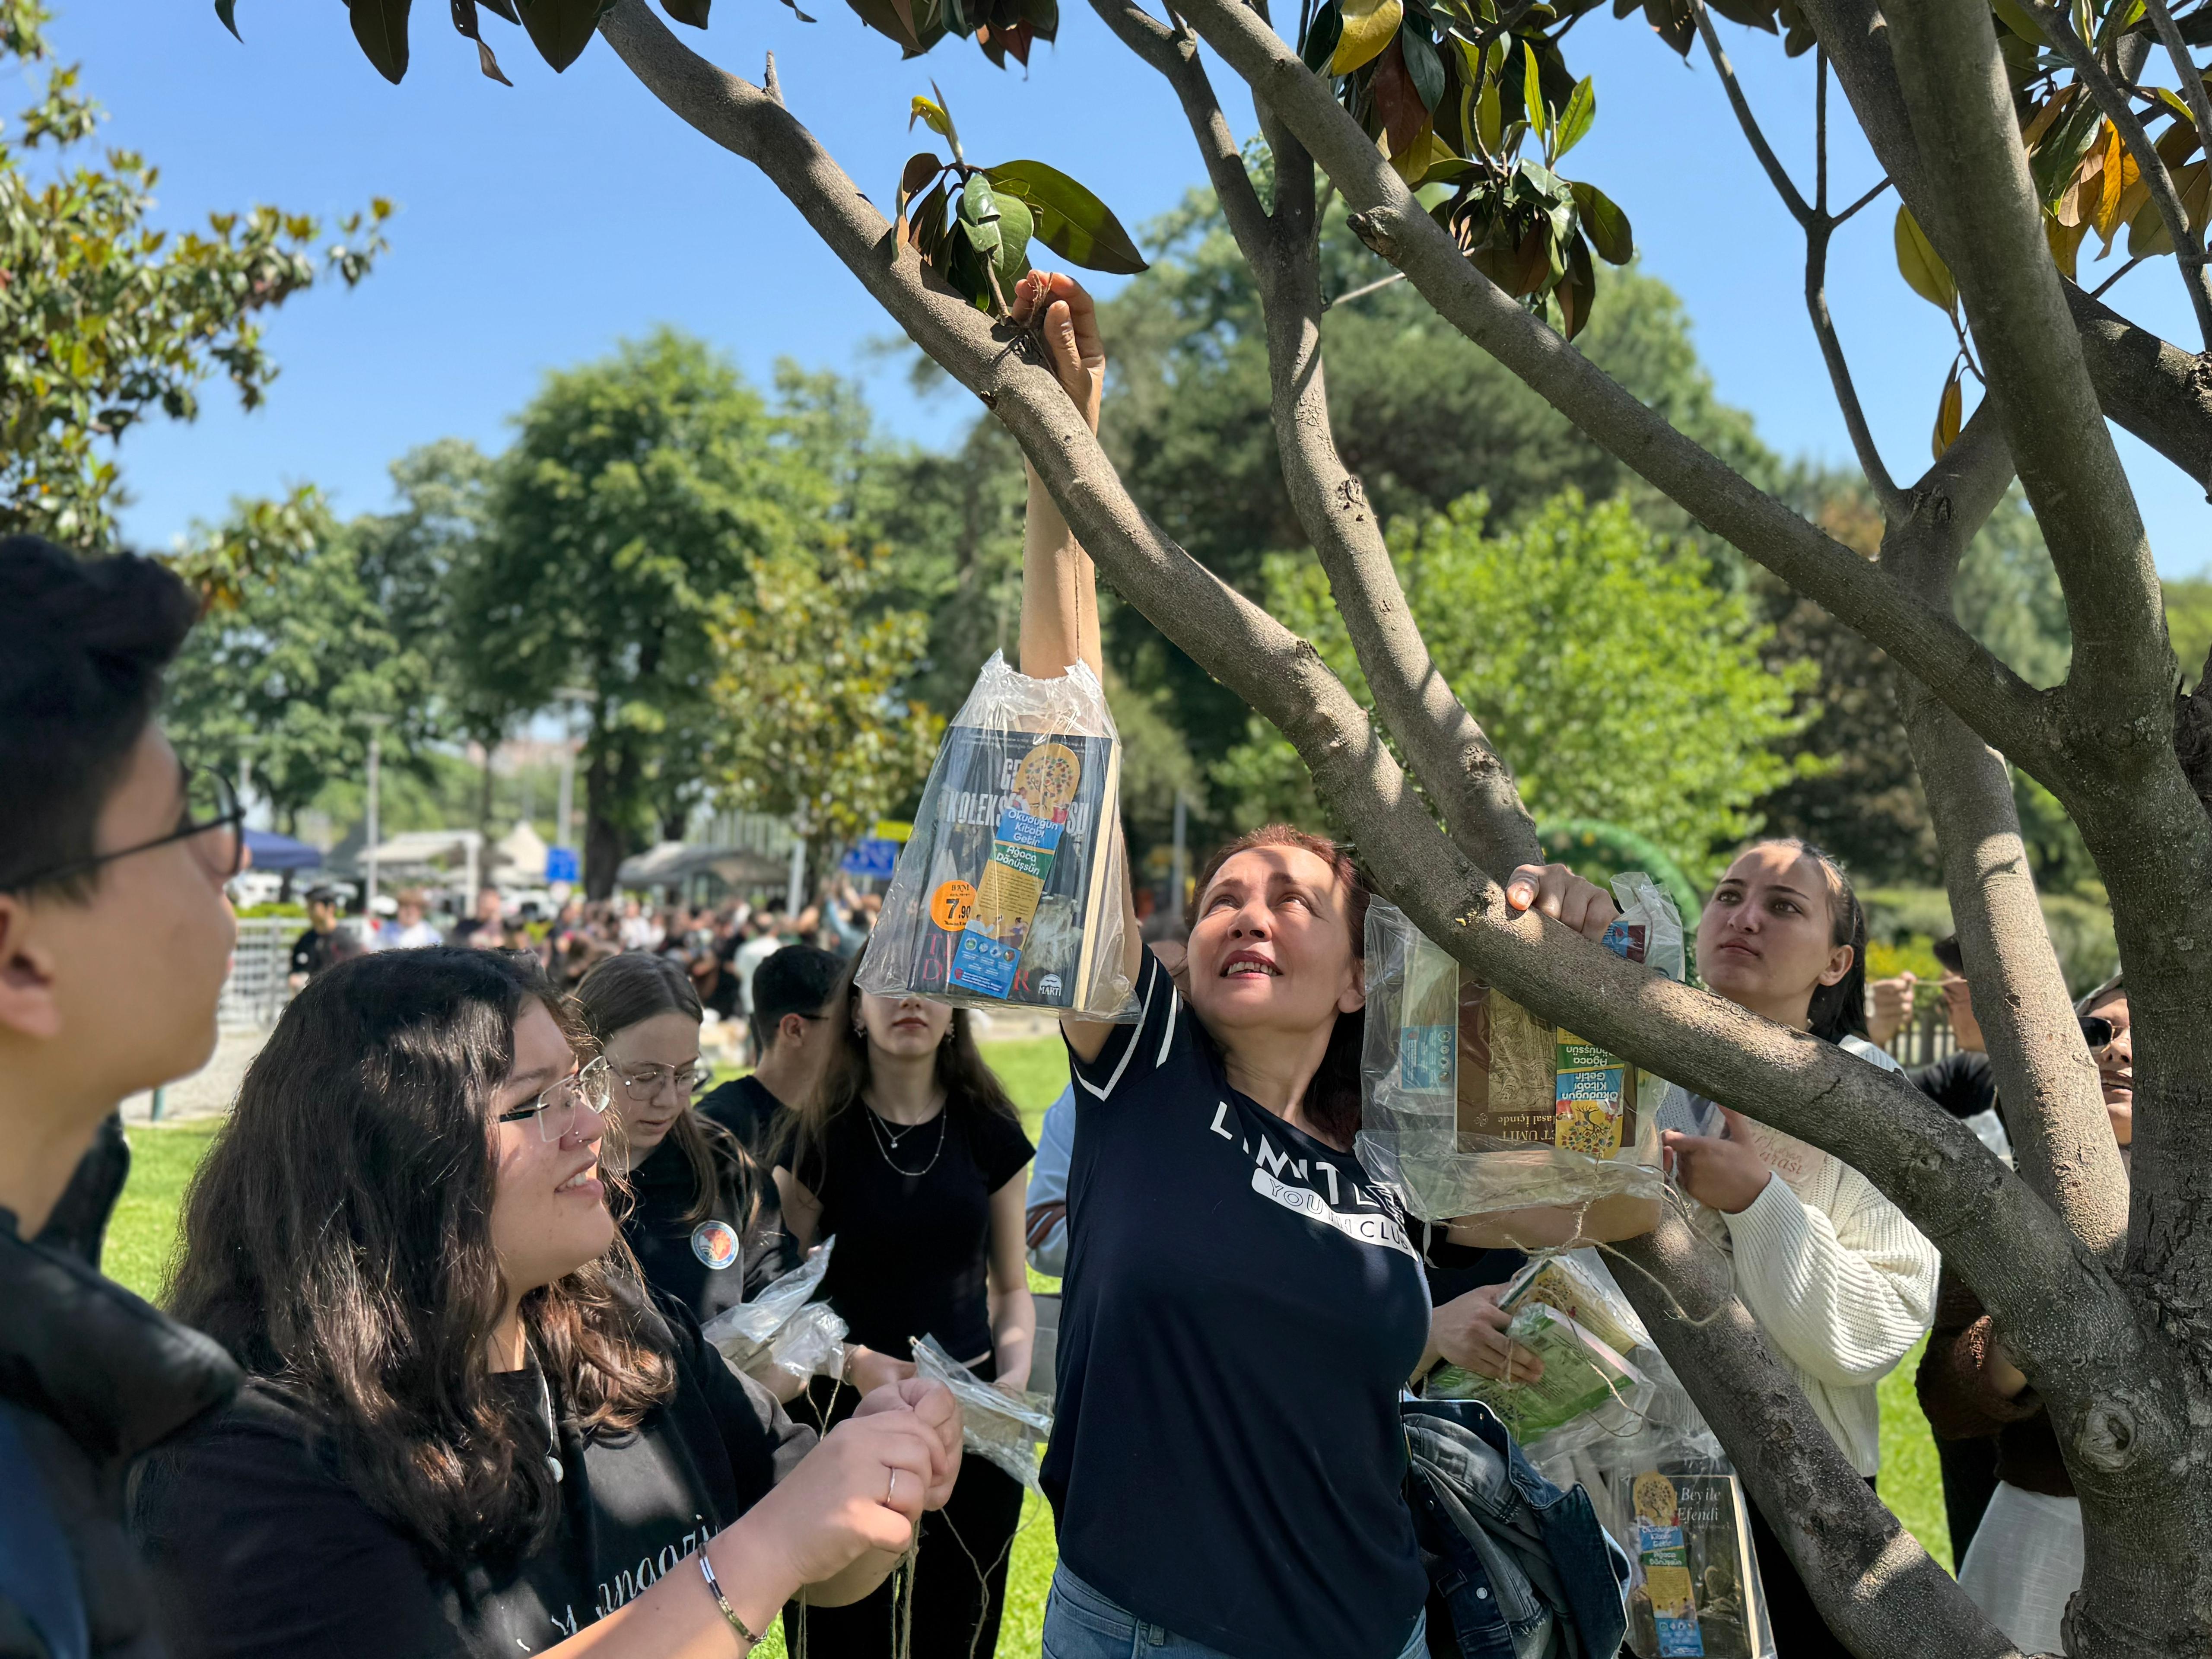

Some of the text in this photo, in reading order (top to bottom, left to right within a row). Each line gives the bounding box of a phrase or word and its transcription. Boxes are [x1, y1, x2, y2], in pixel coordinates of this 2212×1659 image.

[1008, 810, 1058, 830] Okuduğun
[1015, 821, 1045, 837] Kitabı
[1013, 832, 1040, 846] Getir
[1007, 845, 1037, 862] Ağaca
[996, 852, 1040, 875] Dönüşsün
[1566, 1045, 1615, 1057] önüşsün
[1573, 1056, 1608, 1067] Ağaca
[1575, 1072, 1605, 1082] Getir
[1498, 1113, 1555, 1127] asal İçinde
[1681, 1487, 1703, 1504] Bey
[1678, 1507, 1718, 1523] Efendi
